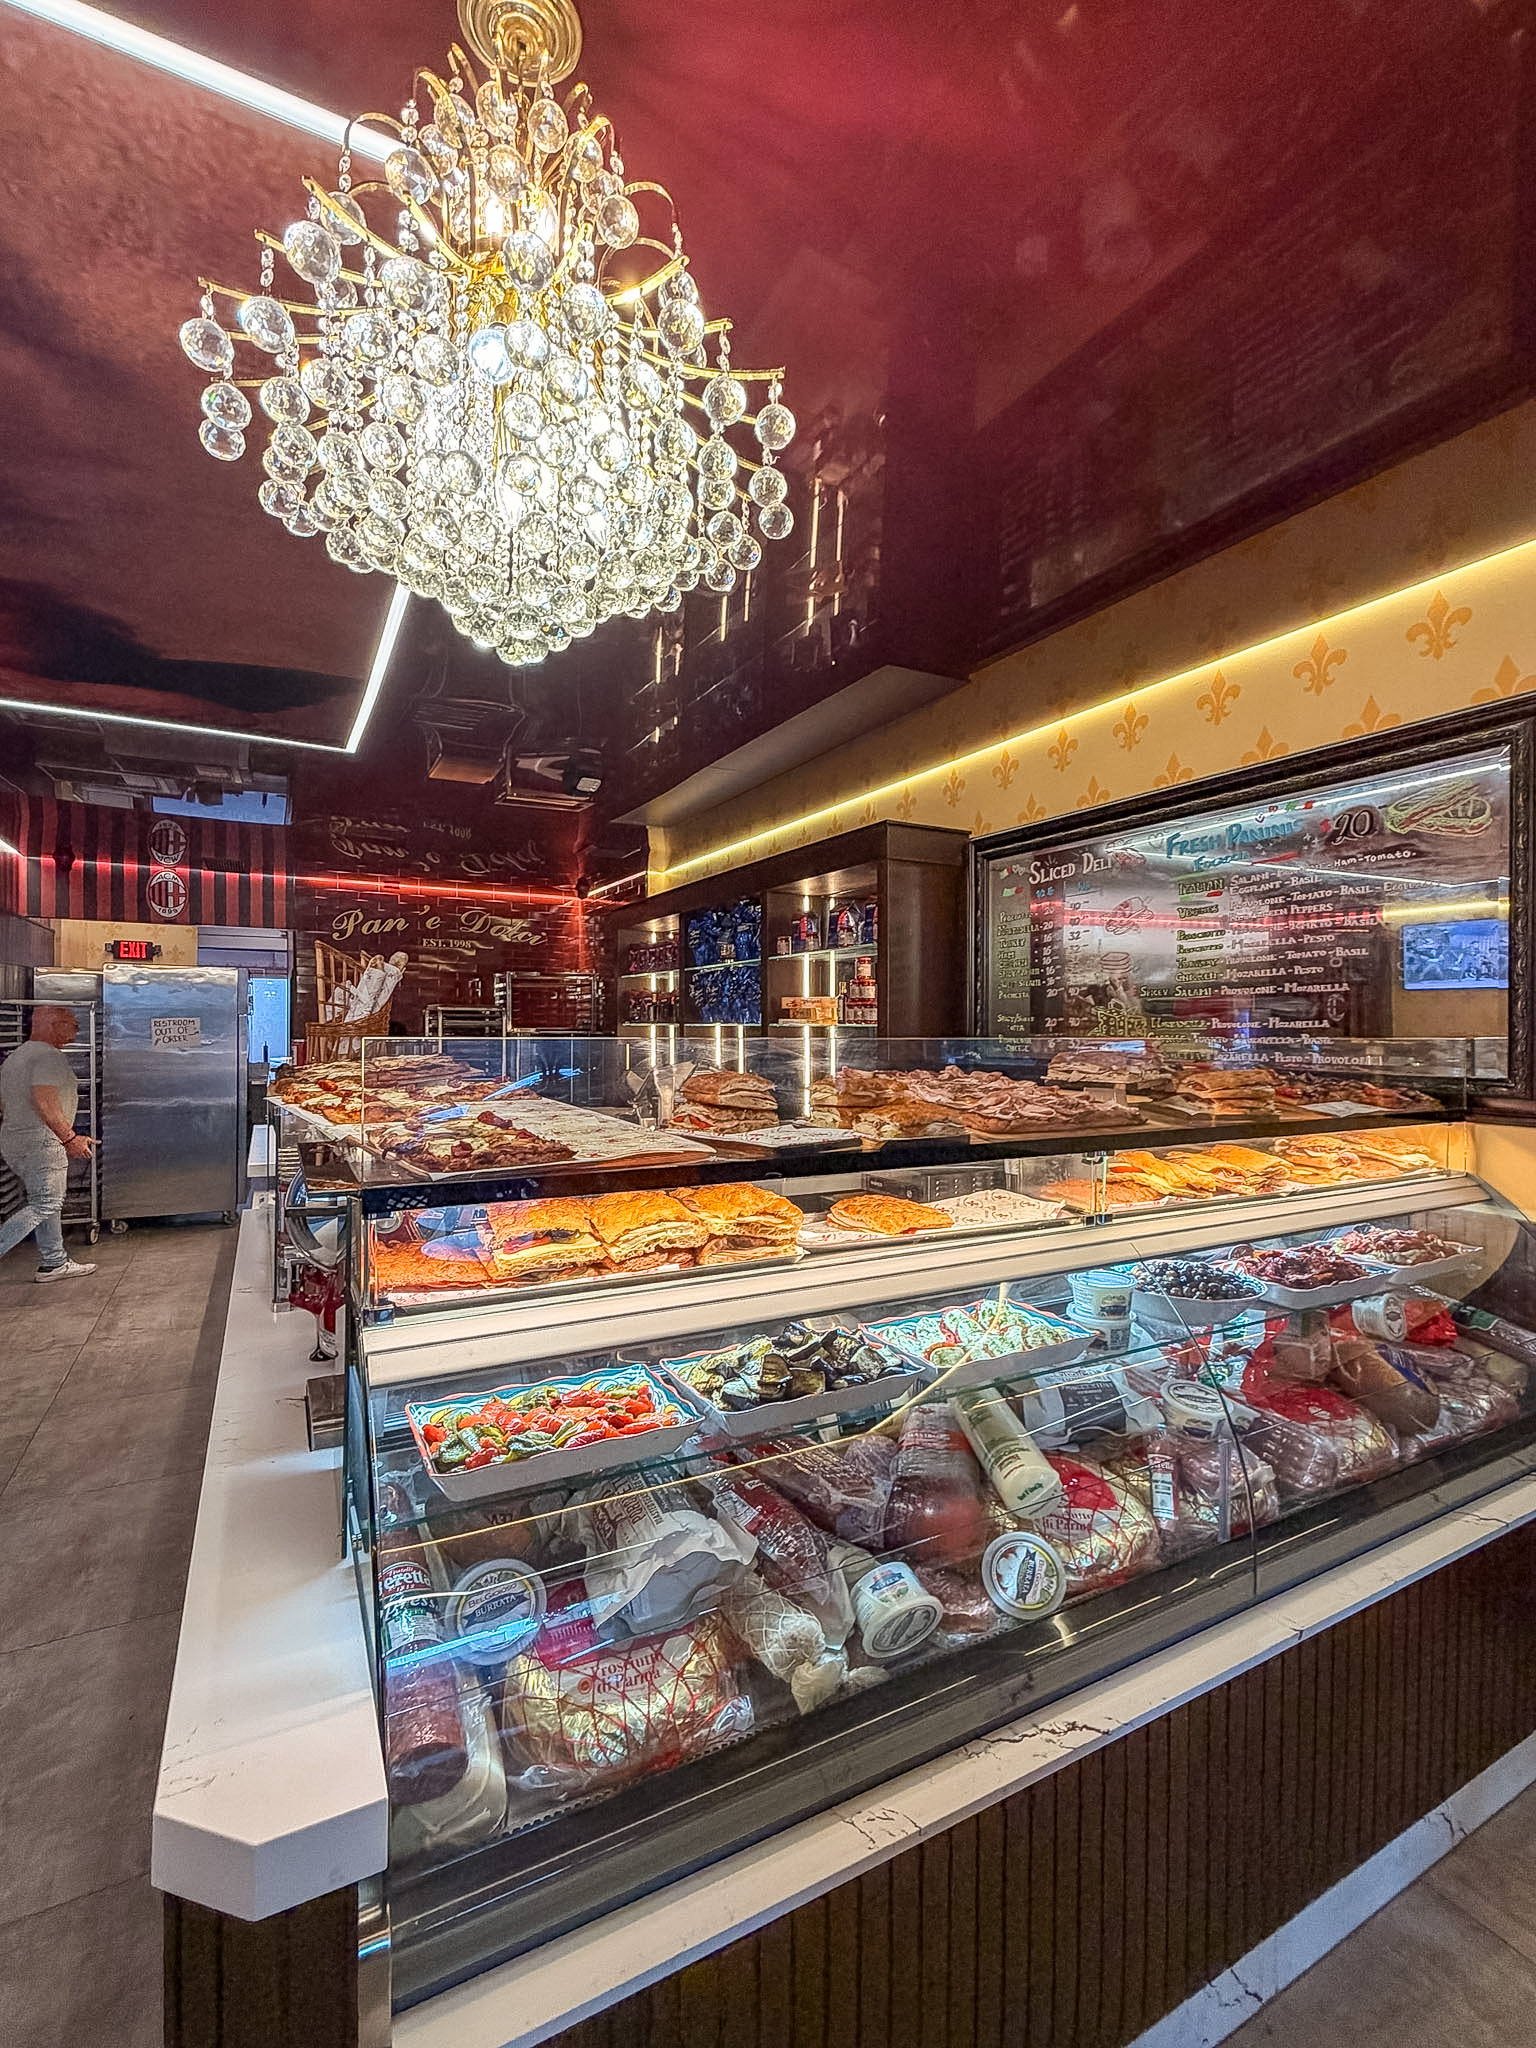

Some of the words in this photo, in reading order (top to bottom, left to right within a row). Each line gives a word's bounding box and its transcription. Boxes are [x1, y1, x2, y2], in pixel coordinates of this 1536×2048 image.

[1028, 861, 1076, 884] SLICED
[1081, 852, 1113, 874] DELI
[155, 873, 180, 884] ACM
[1291, 888, 1333, 901] TOMATO
[1340, 884, 1374, 895] BASIL
[331, 907, 409, 941] Pan
[459, 909, 548, 946] Dolci
[119, 942, 148, 959] EXIT
[422, 938, 447, 949] EST.
[449, 939, 472, 949] 1998
[1285, 949, 1327, 960] TOMATO
[1335, 946, 1369, 957] BASIL
[1294, 965, 1325, 975] PESTO
[1284, 981, 1351, 994] MOZARELLA
[154, 1027, 172, 1036] OUT
[474, 1594, 517, 1618] BURRATA
